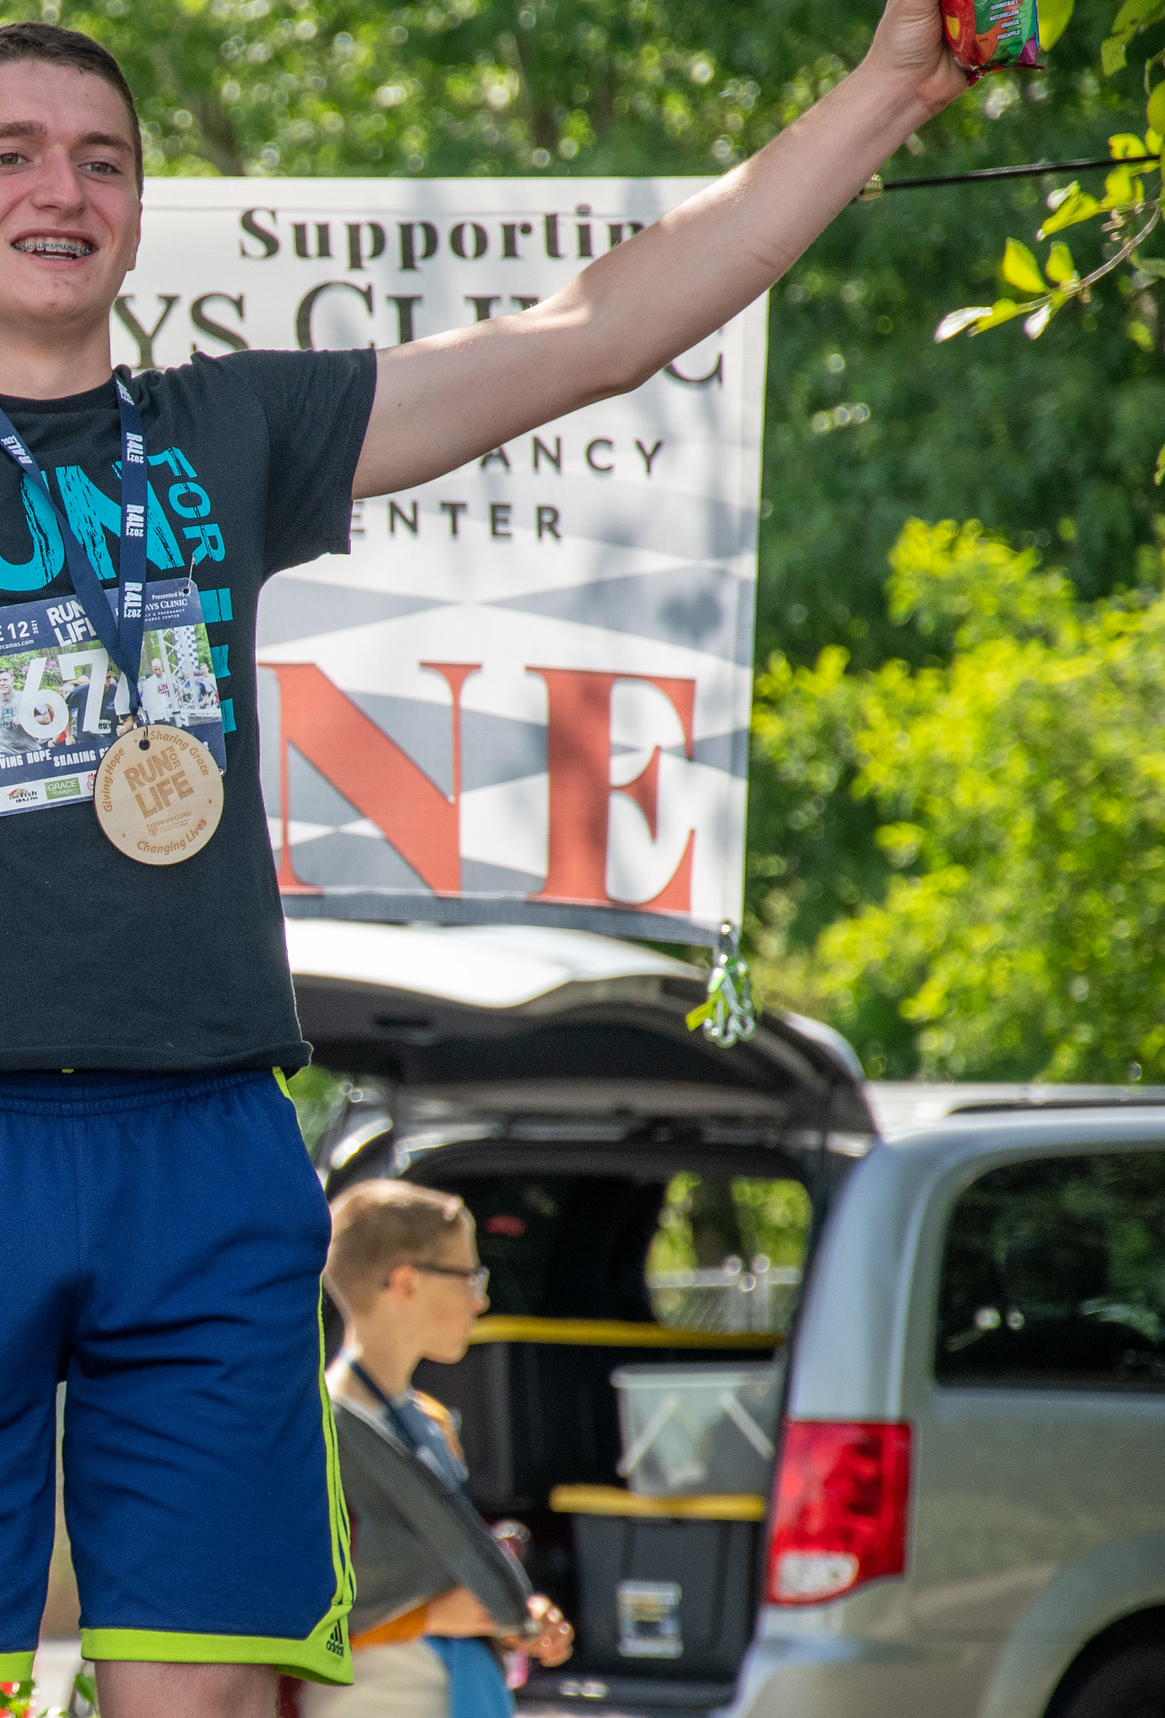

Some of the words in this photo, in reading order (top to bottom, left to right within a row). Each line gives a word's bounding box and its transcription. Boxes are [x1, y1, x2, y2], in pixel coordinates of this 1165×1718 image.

[996, 29, 1021, 40] PINEAPPLE
[1000, 20, 1020, 28] ORANGE
[7, 436, 33, 464] R4L
[126, 432, 144, 458] R4L
[126, 504, 145, 530] R4L
[148, 447, 226, 566] FOR
[126, 528, 144, 537] 2021
[124, 581, 143, 610] R4L
[152, 592, 177, 600] Presented
[160, 599, 188, 609] CLINIC
[123, 609, 141, 619] 2021
[7, 620, 30, 640] 12
[30, 619, 39, 634] 2021
[26, 748, 53, 765] HOPE
[53, 749, 97, 768] SHARING
[105, 748, 125, 777] Hope
[150, 730, 190, 752] Sharing
[188, 747, 209, 776] Grace
[166, 745, 181, 769] FOR
[123, 750, 175, 792] RUN
[47, 779, 77, 791] GRACE
[101, 776, 114, 813] Giving
[134, 769, 195, 820] LIFE
[136, 838, 187, 856] Changing
[185, 818, 208, 844] Lives
[326, 1640, 344, 1657] adidas
